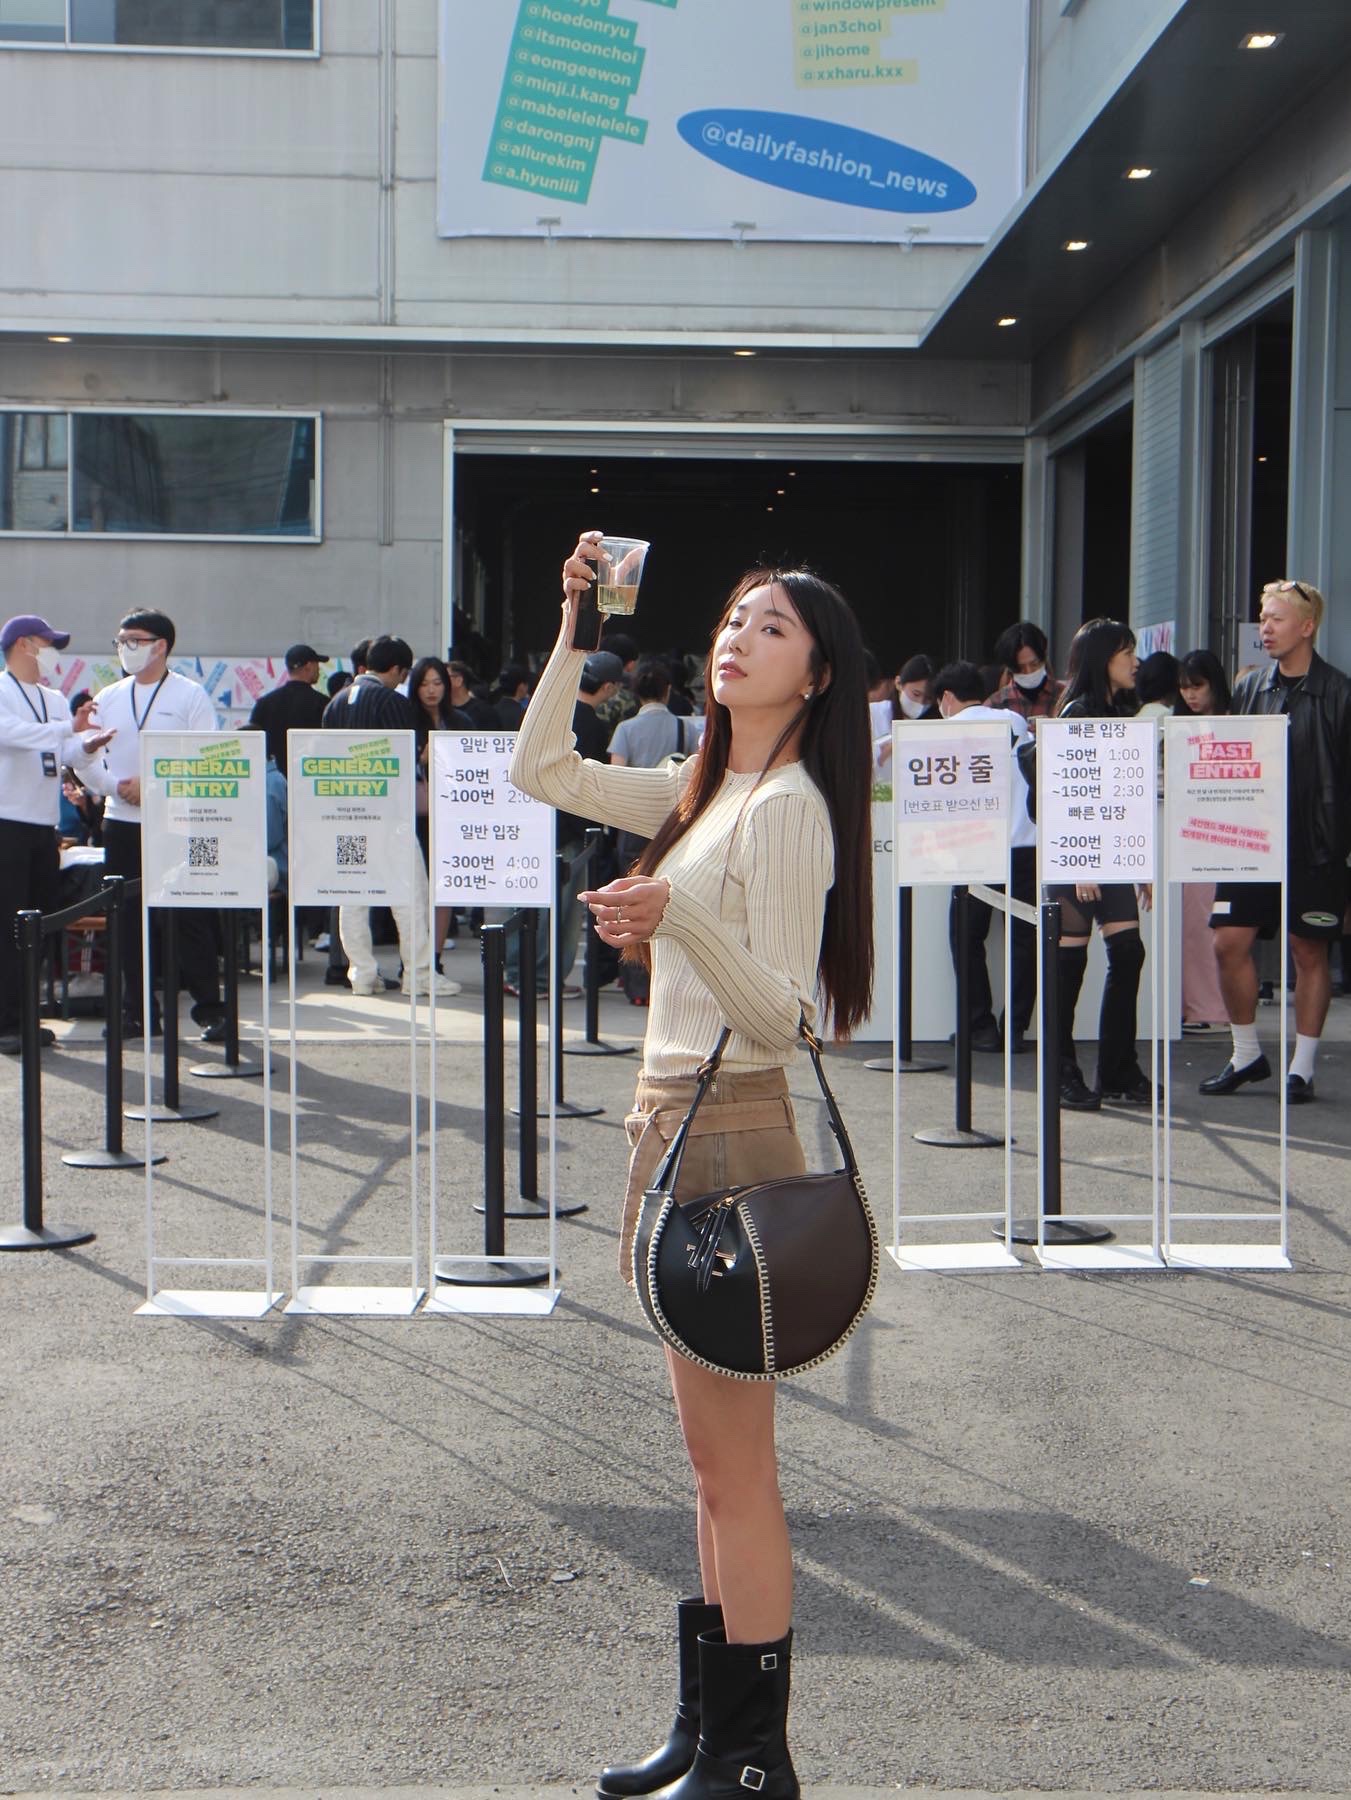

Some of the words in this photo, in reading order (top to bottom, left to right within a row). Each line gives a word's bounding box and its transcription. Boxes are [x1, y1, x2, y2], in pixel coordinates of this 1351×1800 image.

[527, 3, 631, 39] @hoedonryu
[521, 25, 639, 65] @itsmoonchoi
[515, 48, 632, 87] @eomgeewon
[501, 116, 596, 153] @darongmj
[496, 138, 586, 172] @allurekim
[702, 121, 949, 198] @dailyfashion_news
[1068, 723, 1096, 738] 빠른
[1100, 723, 1127, 738] 입장
[460, 737, 488, 753] 일반
[1201, 743, 1250, 760] FAST
[1057, 748, 1097, 763] ~50번
[1109, 749, 1140, 761] 1:00
[155, 760, 249, 776] GENERAL
[303, 759, 399, 775] GENERAL
[908, 755, 960, 786] 입장
[968, 754, 994, 783] 줄
[1052, 766, 1101, 781] ~100번
[1113, 767, 1144, 779] 2:00
[1193, 764, 1259, 778] ENTRY
[445, 768, 489, 785] ~50번
[169, 782, 236, 797] ENTRY
[318, 780, 385, 795] ENTRY
[1052, 784, 1101, 799] ~150번
[1113, 785, 1144, 797] 2:30
[441, 789, 494, 805] ~100번
[904, 799, 943, 814] [번호표
[946, 798, 981, 813] 받으신
[984, 797, 1000, 811] 분]
[1068, 806, 1095, 821] 빠른
[1099, 806, 1127, 821] 입장
[460, 824, 488, 840] 일반
[493, 824, 520, 840] 입장
[1050, 835, 1101, 850] ~200번
[1113, 835, 1146, 848] 3:00
[442, 855, 494, 871] ~300번
[507, 856, 540, 869] 4:00
[1050, 853, 1101, 868] ~300번
[1112, 854, 1146, 867] 4:00
[443, 875, 496, 890] 301번~
[505, 876, 538, 889] 6:00
